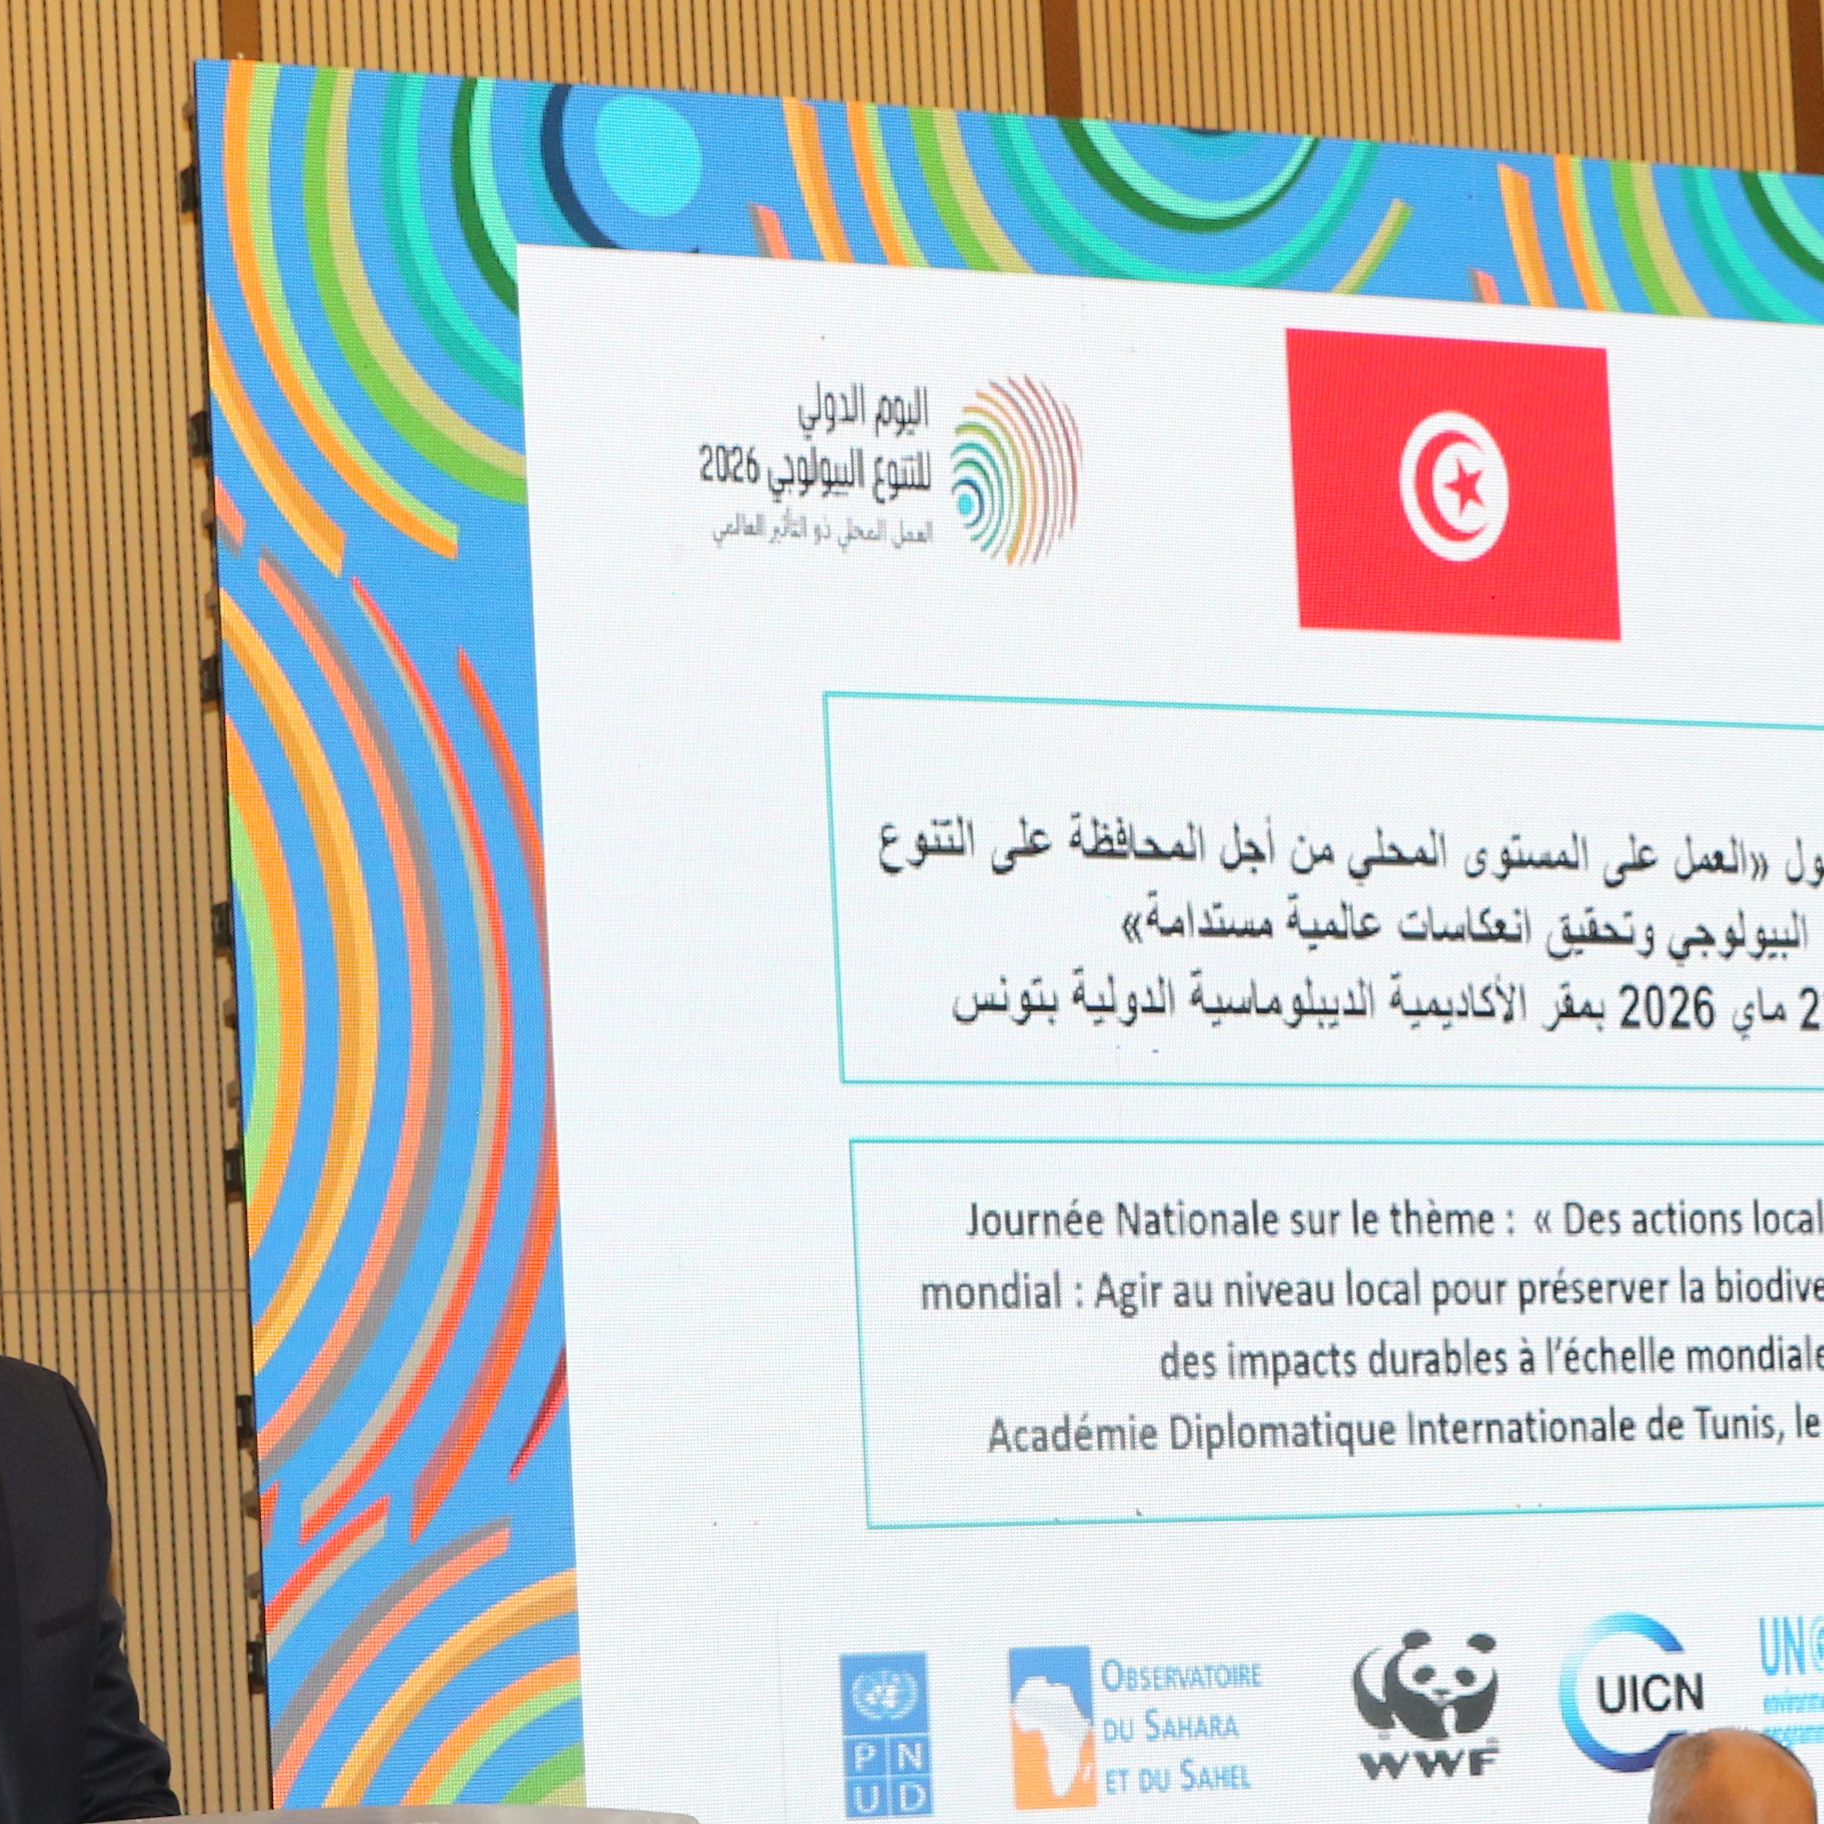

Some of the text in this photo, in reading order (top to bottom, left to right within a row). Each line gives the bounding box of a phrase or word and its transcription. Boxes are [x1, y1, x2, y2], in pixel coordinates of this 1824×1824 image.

[797, 381, 929, 441] اليوم الدولي
[699, 443, 932, 505] للتنوع البيولوجي 2026
[879, 815, 974, 876] التنوع
[991, 817, 1052, 876] على
[1069, 812, 1205, 862] المحافظة
[1220, 815, 1275, 874] أجل
[1291, 835, 1335, 876] من
[1347, 827, 1445, 887] المحلي
[1465, 832, 1587, 882] المستوى
[1603, 834, 1658, 890] على
[1286, 892, 1382, 951] عالمية
[1399, 900, 1531, 944] انعكاسات
[1547, 906, 1655, 961] وتحقيق
[1667, 910, 1806, 966] البيولوجي
[953, 976, 1059, 1027] بتونس
[1072, 966, 1175, 1028] الدولية
[1190, 968, 1374, 1030] الديبلوماسية
[1389, 972, 1526, 1030] الأكاديمية
[1546, 981, 1606, 1032] بمقر
[1619, 983, 1716, 1030] 2026
[1732, 987, 1787, 1040] ماي
[966, 1198, 1105, 1238] Journée
[1116, 1198, 1280, 1237] Nationale
[1290, 1208, 1342, 1237] sur
[1351, 1198, 1380, 1236] le
[1389, 1198, 1495, 1236] thème
[1564, 1200, 1622, 1236] Des
[1632, 1199, 1743, 1236] actions
[921, 1269, 1062, 1310] mondial
[1094, 1271, 1163, 1320] Agir
[1173, 1280, 1213, 1309] au
[1224, 1270, 1335, 1308] niveau
[1345, 1267, 1421, 1307] local
[1432, 1278, 1508, 1316] pour
[1518, 1267, 1670, 1315] préserver
[1679, 1266, 1706, 1304] la
[1160, 1340, 1218, 1380] des
[1227, 1341, 1358, 1387] impacts
[1368, 1337, 1508, 1377] durables
[1519, 1337, 1536, 1375] à
[988, 1412, 1158, 1453] Académie
[1169, 1410, 1397, 1460] Diplomatique
[1407, 1404, 1637, 1445] Internationale
[1646, 1404, 1685, 1441] de
[1693, 1404, 1785, 1445] Tunis,
[1795, 1401, 1821, 1439] le
[1597, 1672, 1704, 1715] UICN
[1358, 1746, 1500, 1781] WWF
